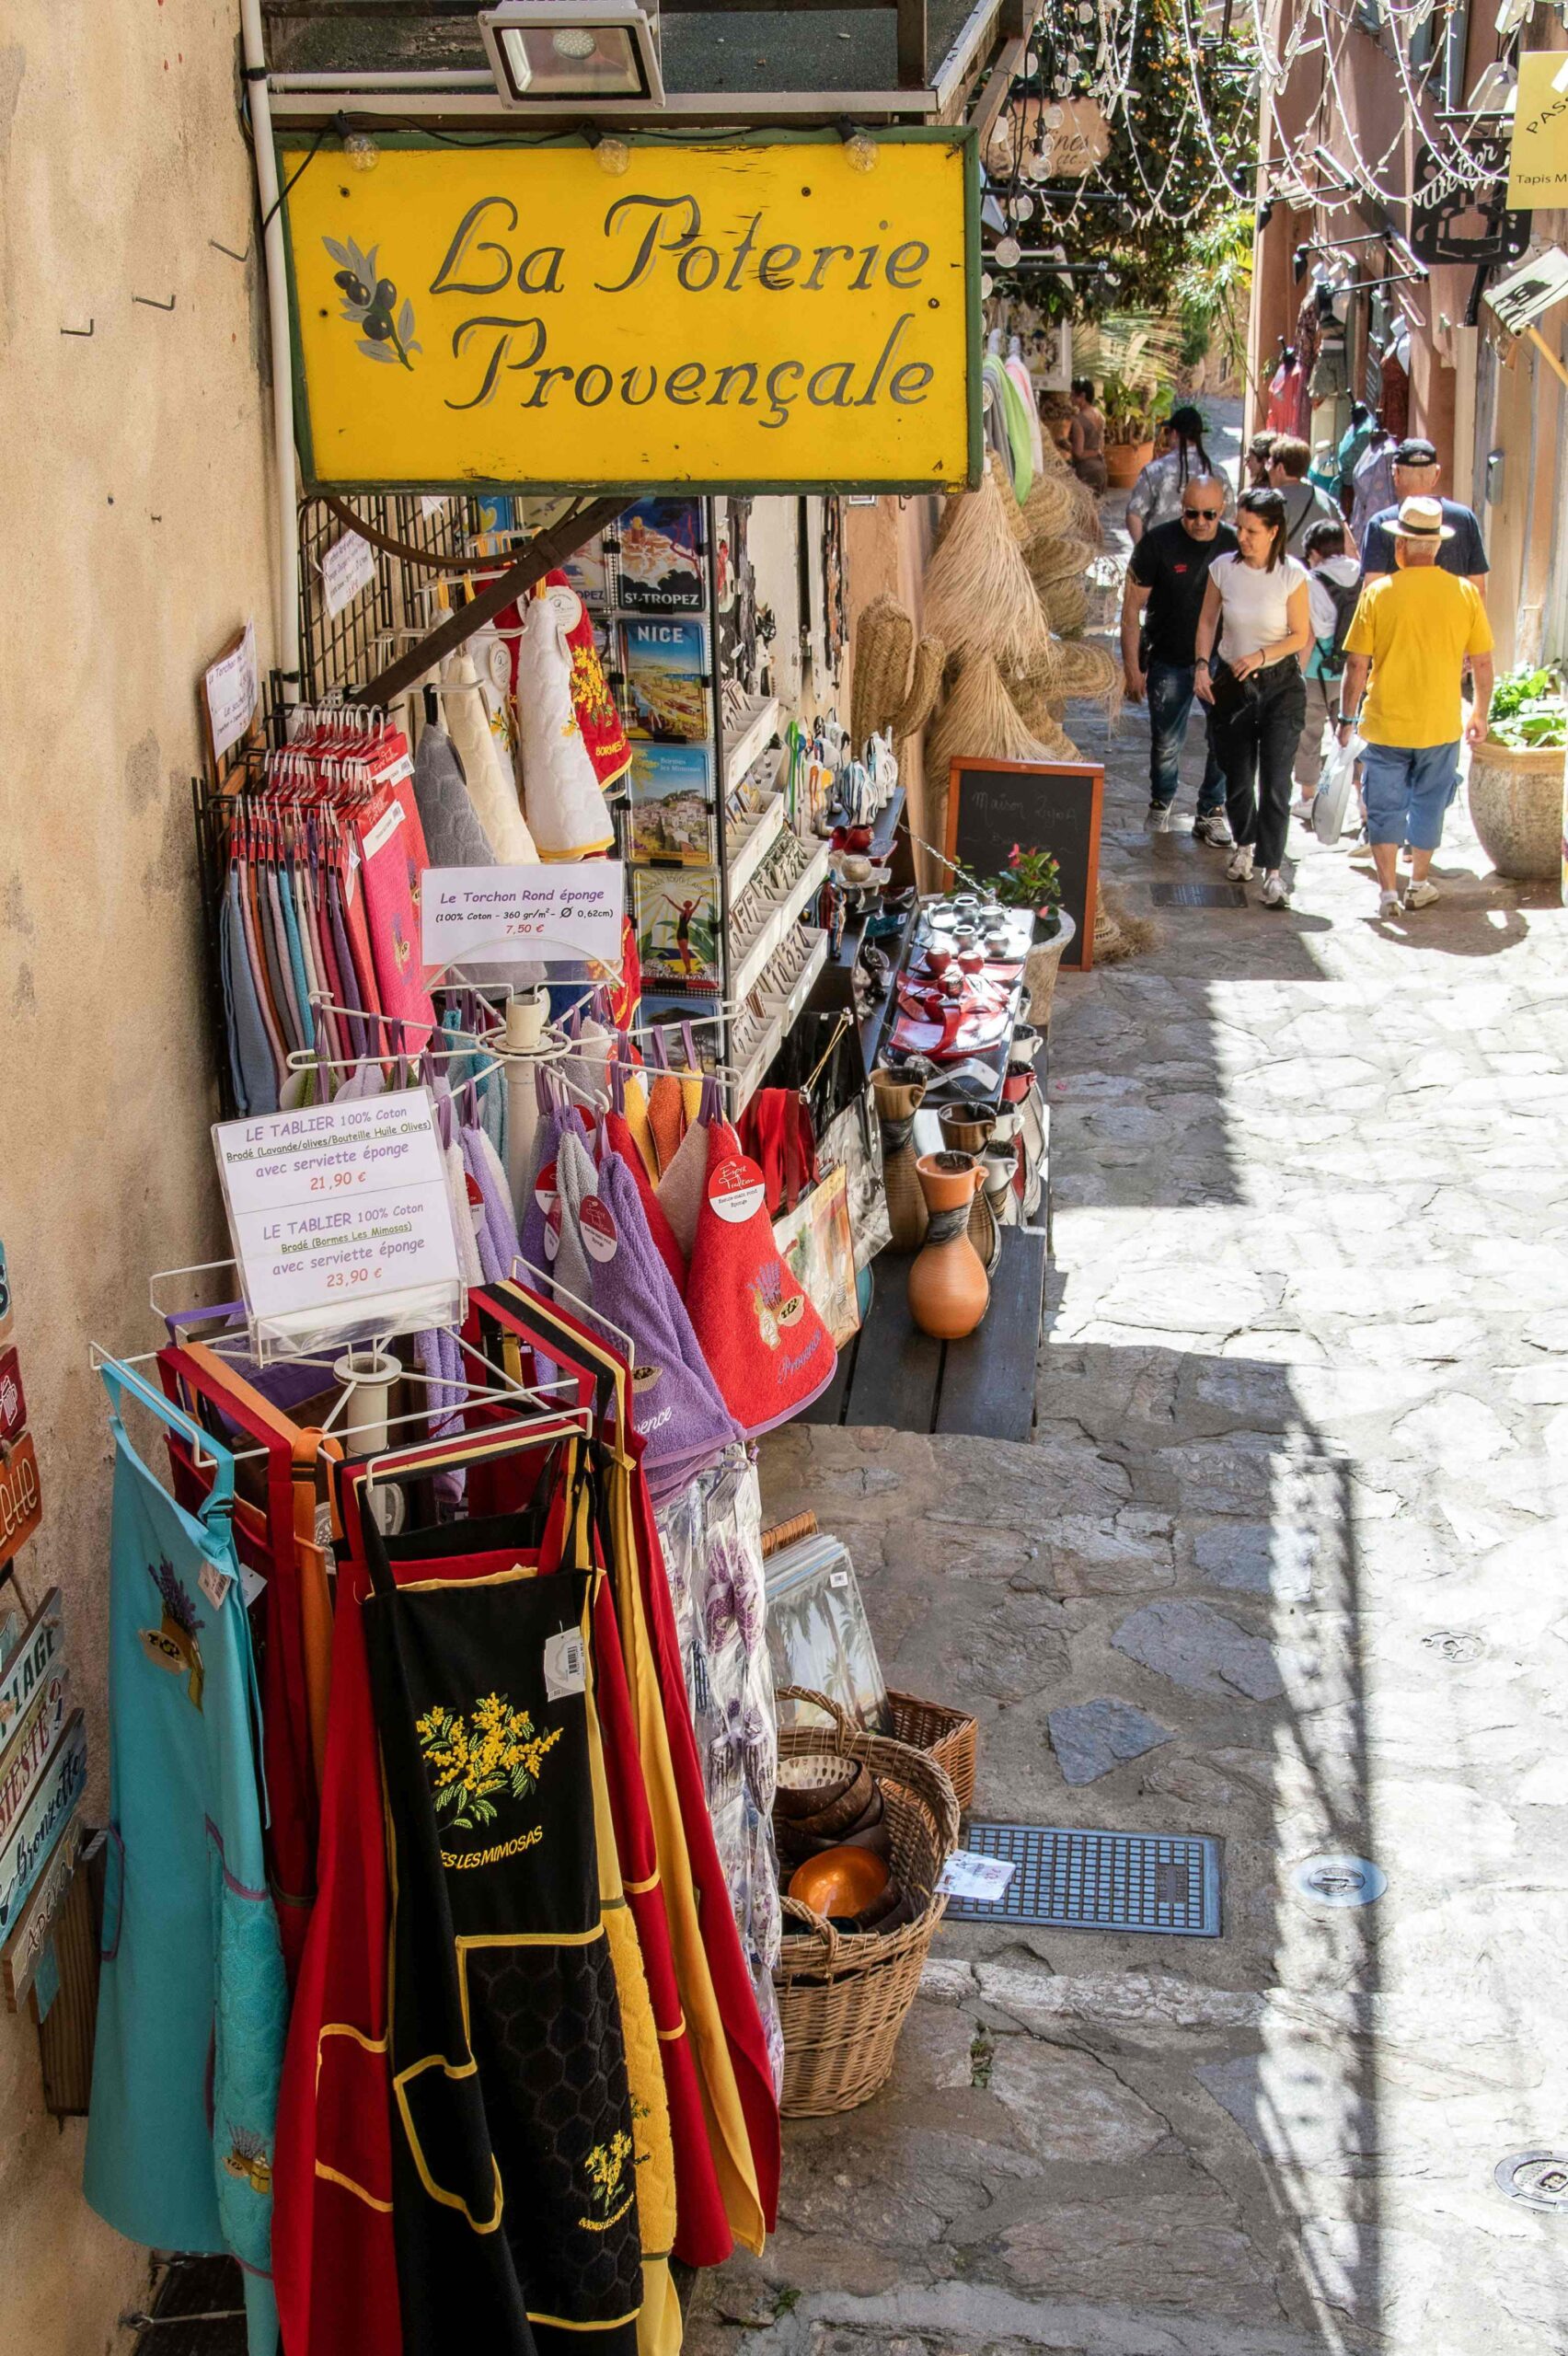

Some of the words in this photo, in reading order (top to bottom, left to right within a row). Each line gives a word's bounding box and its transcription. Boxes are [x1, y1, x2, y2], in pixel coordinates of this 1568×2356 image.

[1516, 174, 1551, 186] Tapis
[429, 195, 566, 294] La
[594, 194, 929, 293] Poterie
[444, 313, 935, 429] Provençale
[638, 626, 684, 642] NICE
[440, 893, 456, 905] Le
[464, 891, 516, 903] Torchon
[522, 889, 554, 901] Rond
[559, 889, 605, 904] éponge
[435, 913, 464, 923] (100%
[467, 912, 492, 920] Coton
[502, 910, 521, 919] 360
[577, 908, 614, 918] 0,62cm)
[506, 924, 532, 935] 7,50
[536, 923, 544, 933] €
[226, 1148, 254, 1162] Brodé
[258, 1131, 372, 1158] (Lavande/olives/Bouteille
[375, 1127, 398, 1139] Huile
[400, 1119, 432, 1135] Olives)
[246, 1126, 264, 1142] LE
[271, 1115, 335, 1138] TABLIER
[340, 1111, 373, 1127] 100%
[375, 1106, 408, 1121] Coton
[256, 1163, 287, 1178] avec
[294, 1149, 357, 1172] serviette
[363, 1142, 409, 1161] éponge
[310, 1172, 352, 1192] 21,90
[358, 1172, 366, 1183] €
[263, 1224, 282, 1241] LE
[287, 1212, 352, 1235] TABLIER
[358, 1207, 388, 1223] 100%
[393, 1202, 424, 1217] Coton
[281, 1239, 309, 1253] Brodé
[312, 1234, 349, 1249] (Bormes
[352, 1230, 367, 1241] Les
[371, 1221, 412, 1238] Mimosas)
[272, 1260, 304, 1276] avec
[310, 1246, 374, 1269] serviette
[379, 1238, 425, 1256] éponge
[327, 1268, 368, 1288] 23,90
[374, 1267, 383, 1278] €
[778, 1328, 822, 1385] Provence
[16, 1749, 84, 1888] Bronzette
[480, 1825, 543, 1865] MIMOSAS
